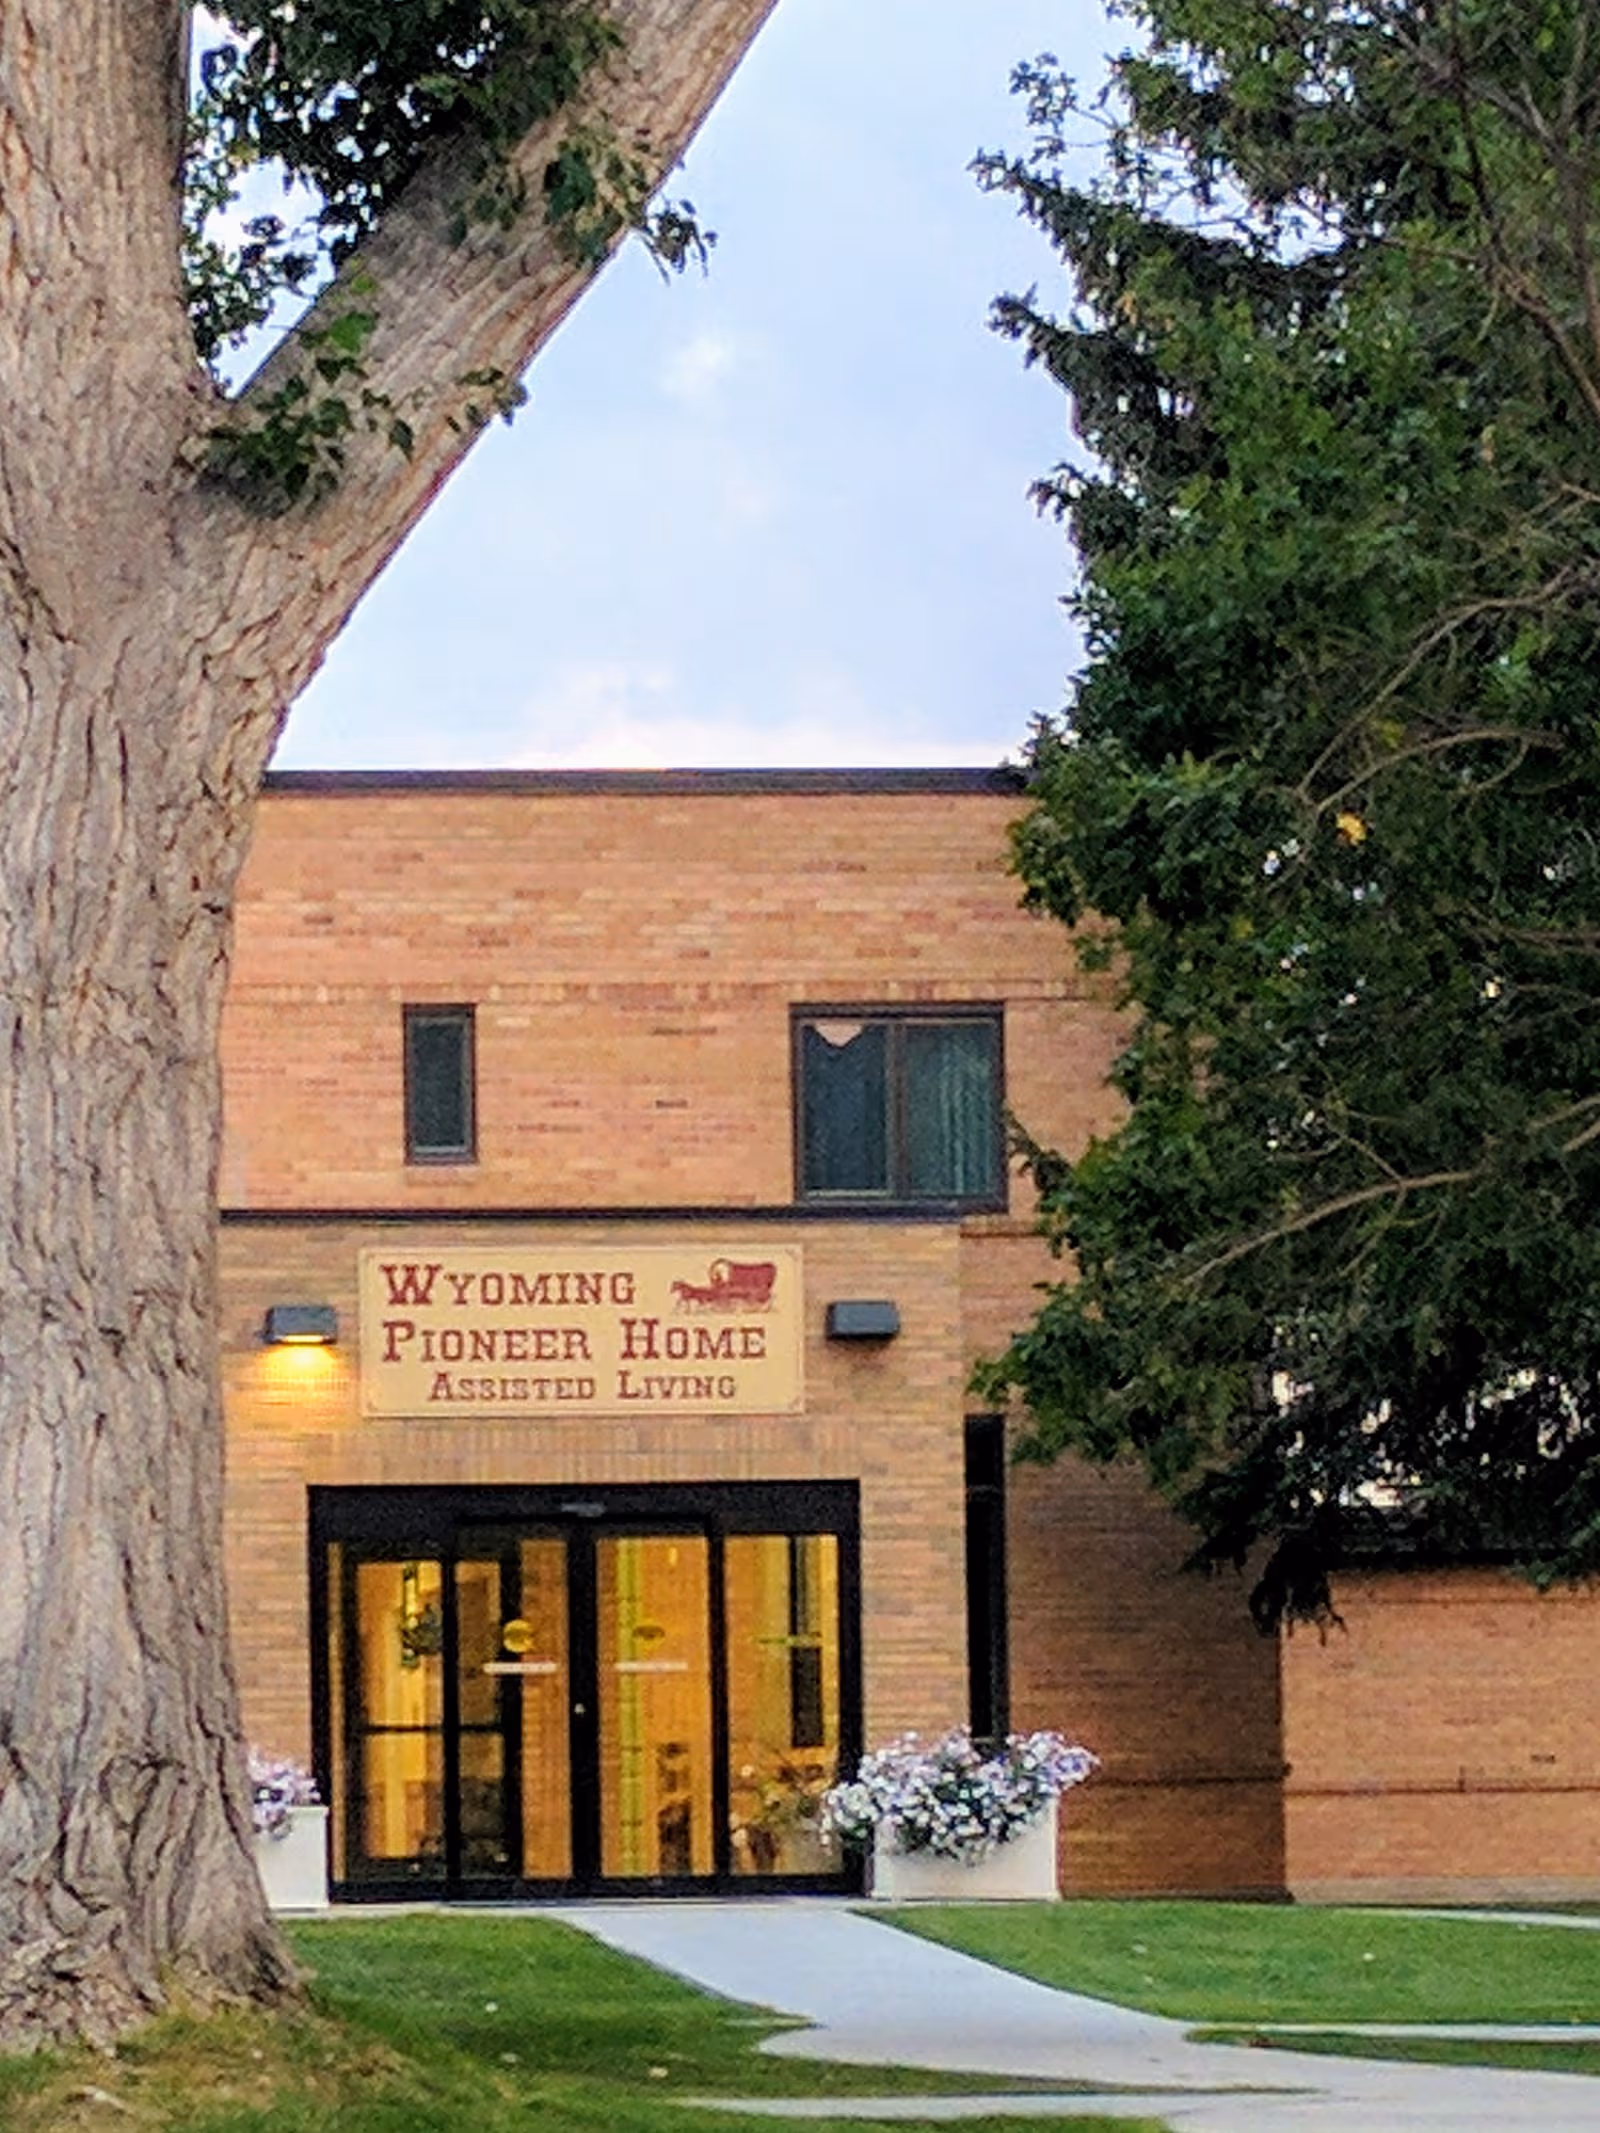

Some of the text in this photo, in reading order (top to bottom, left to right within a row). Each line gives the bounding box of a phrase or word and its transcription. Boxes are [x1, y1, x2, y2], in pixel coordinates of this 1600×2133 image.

[380, 1263, 637, 1306] WYOMING
[382, 1317, 767, 1362] PIONEER HOME
[427, 1369, 736, 1402] ASSISTED LIVING
